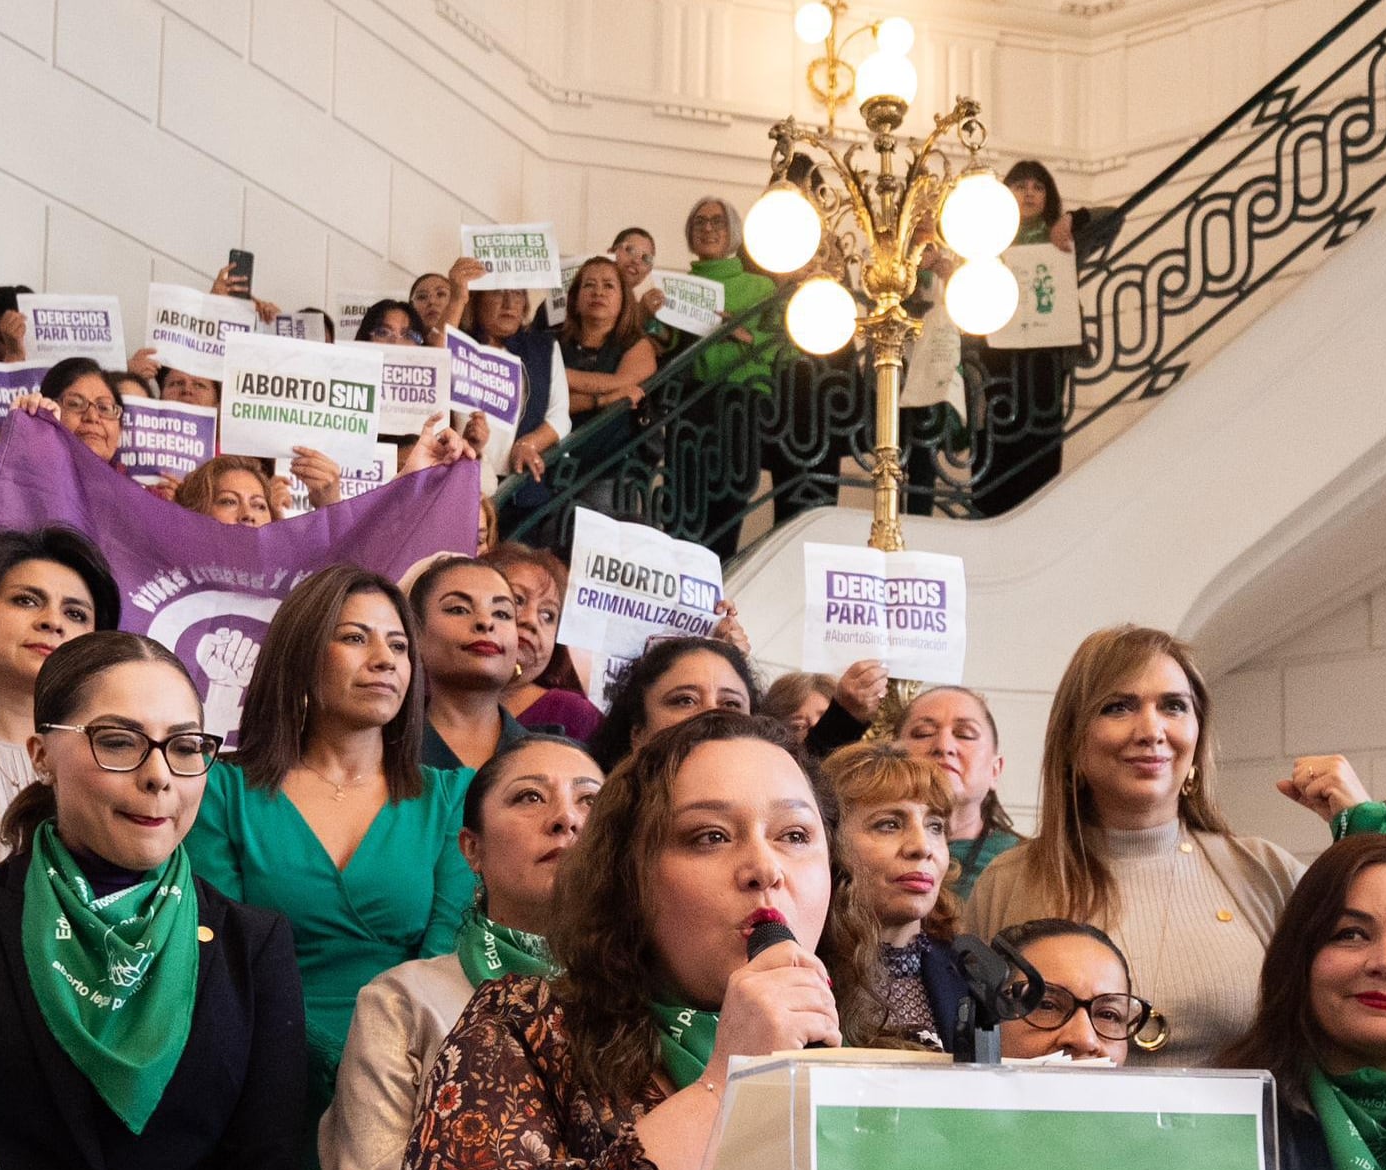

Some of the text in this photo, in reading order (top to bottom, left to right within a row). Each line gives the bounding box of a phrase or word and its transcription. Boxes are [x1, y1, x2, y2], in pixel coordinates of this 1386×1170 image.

[474, 247, 549, 259] UN DERECHO
[476, 234, 543, 247] DECIDIR ES
[497, 260, 511, 272] UN
[515, 259, 551, 272] DELITO
[37, 310, 106, 327] DERECHOS
[160, 309, 215, 337] ABORTO
[35, 327, 112, 342] PARA TODAS
[458, 345, 510, 378] EL ABORTO ES
[241, 373, 326, 403] ABORTO
[332, 384, 368, 411] SIN
[452, 359, 515, 398] UN DERECHO
[390, 386, 437, 404] TODAS
[454, 380, 510, 412] NO UN DELITO
[135, 414, 182, 432] ABORTO
[183, 420, 198, 436] ES
[231, 402, 369, 435] CRIMINALIZACIÓN
[135, 430, 205, 458] DERECHO
[121, 452, 197, 473] NO UN DELITO
[590, 554, 716, 612] ABORTO SIN
[833, 574, 941, 607] DERECHOS
[577, 586, 714, 636] CRIMINALIZACIÓN
[826, 602, 947, 633] PARA TODAS
[51, 960, 89, 997] aborto
